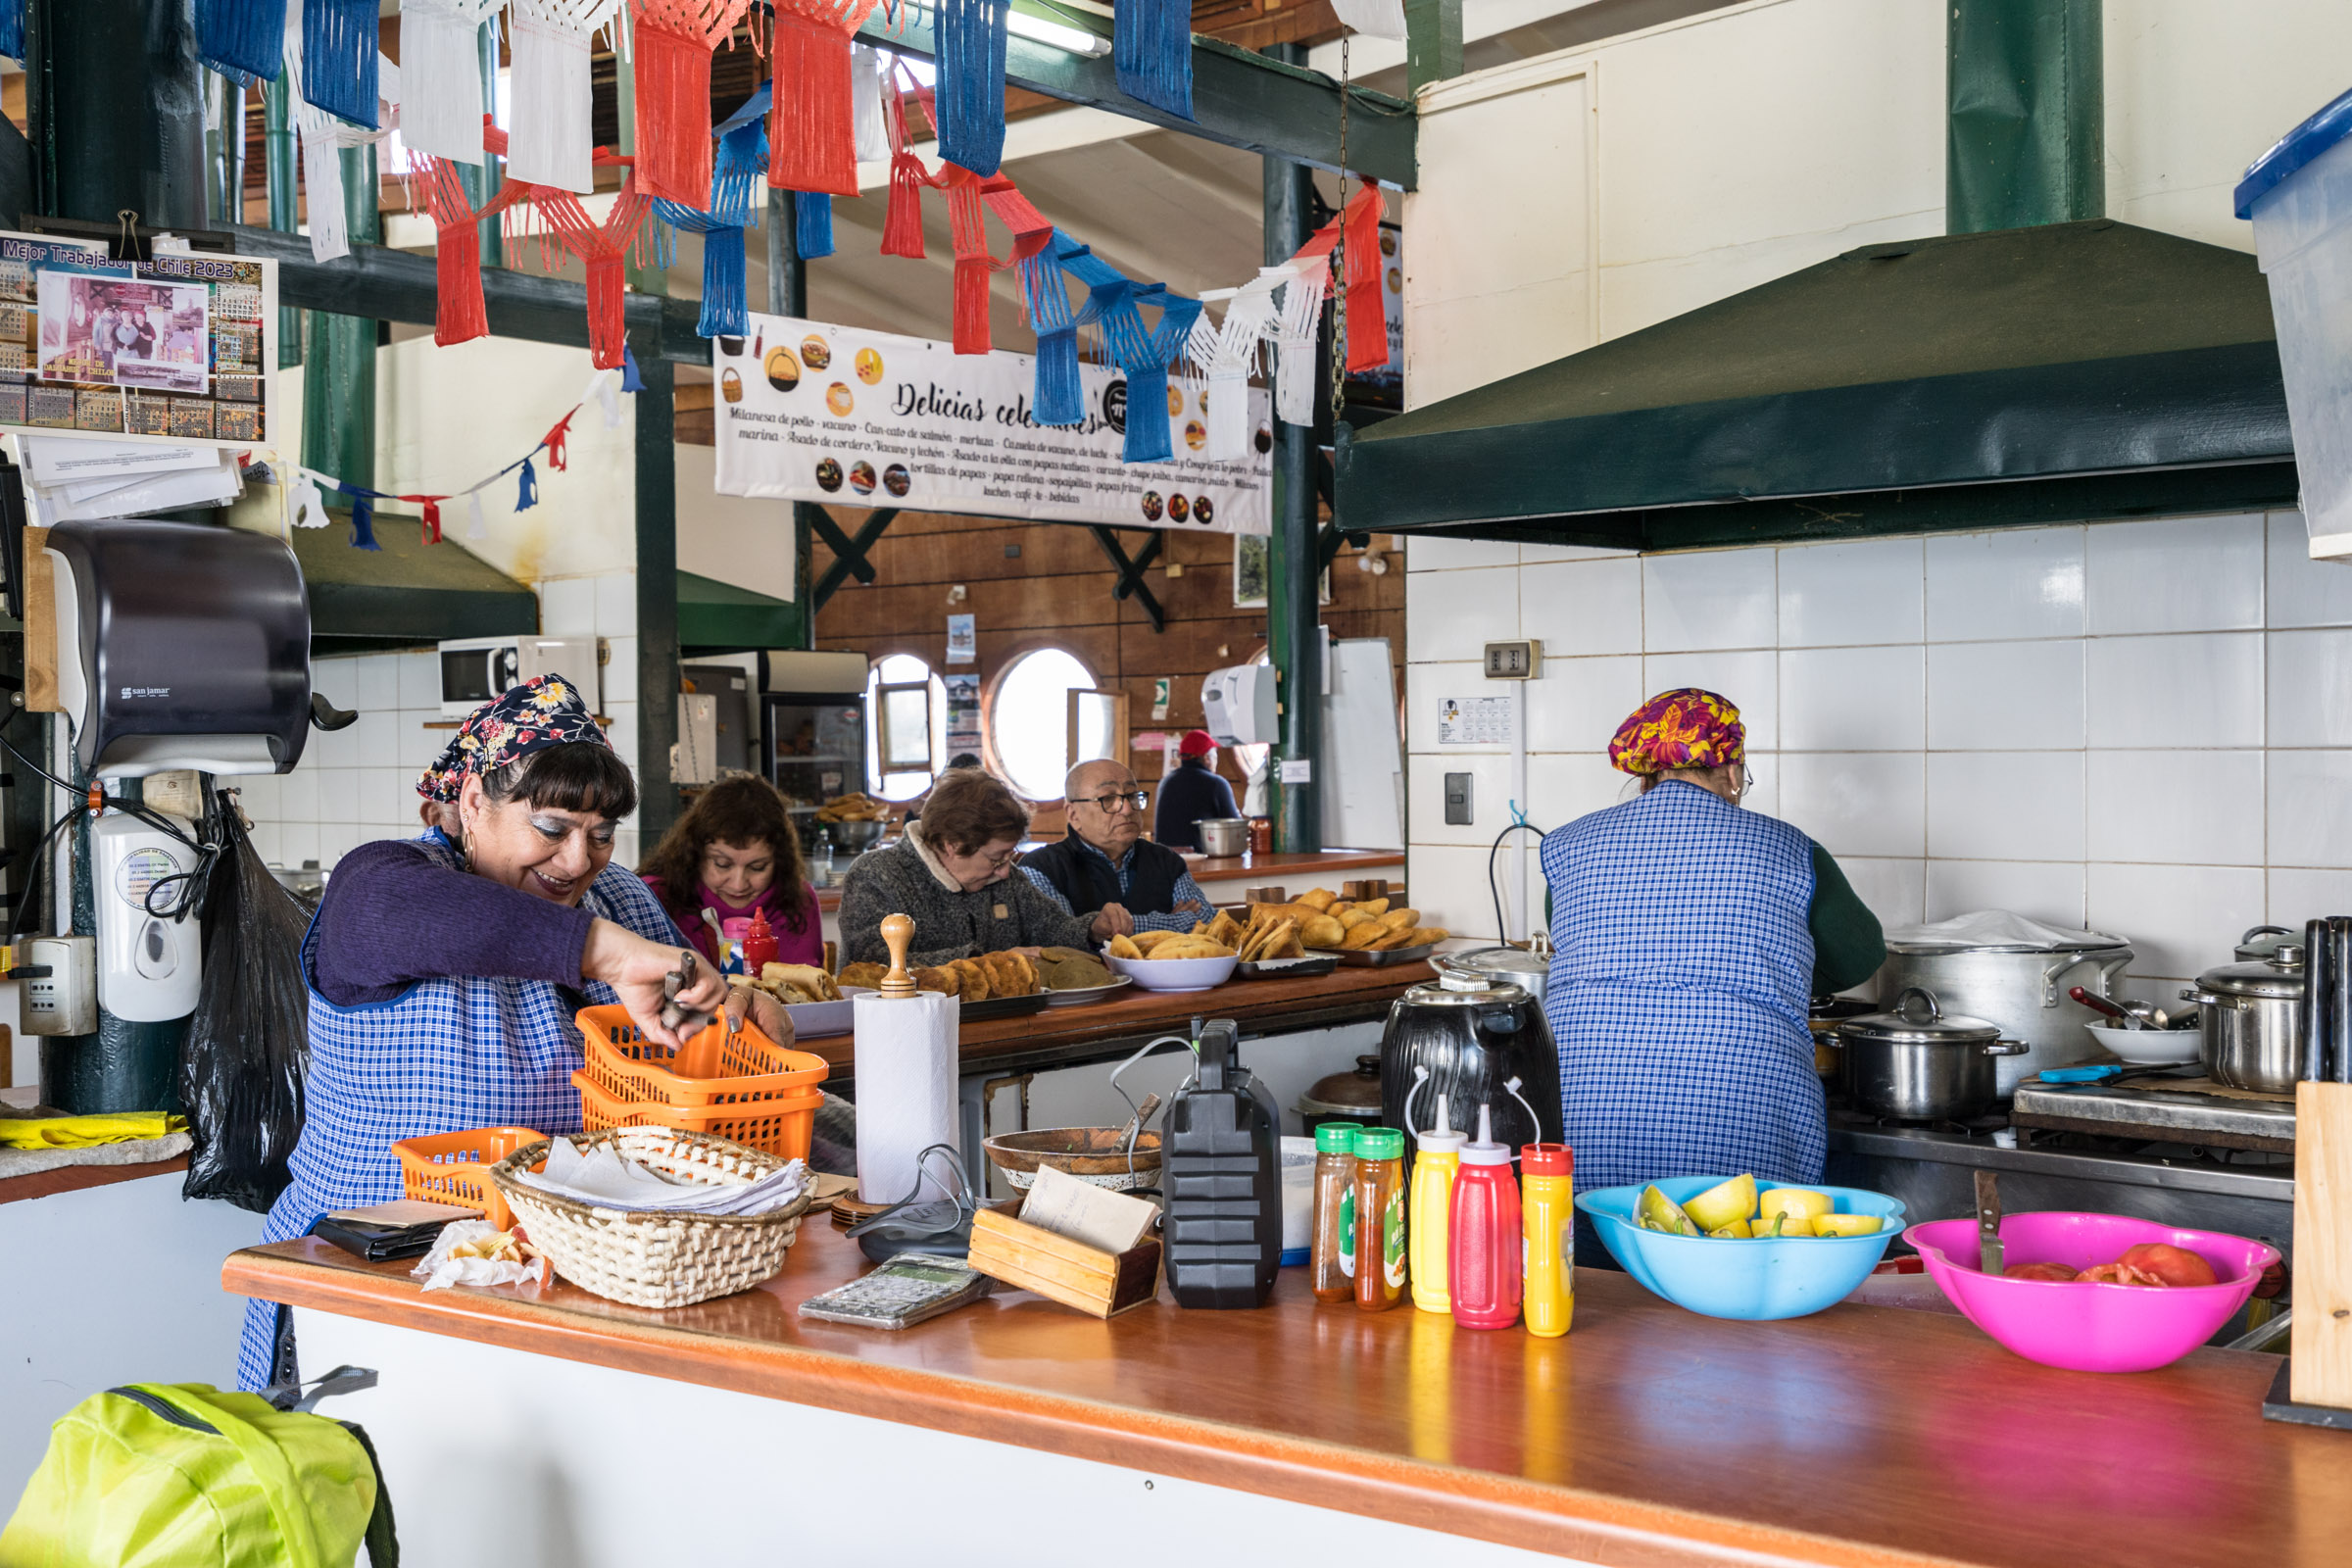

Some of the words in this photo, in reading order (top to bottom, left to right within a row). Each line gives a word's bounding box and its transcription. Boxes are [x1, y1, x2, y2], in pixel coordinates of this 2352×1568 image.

[3, 240, 47, 262] Mejor
[50, 246, 132, 269] Trabajador
[157, 258, 191, 274] Chile
[195, 261, 234, 278] 2023
[890, 381, 987, 421] Delicias
[729, 407, 776, 423] Milanesa
[778, 414, 789, 424] de
[791, 416, 814, 428] pollo
[822, 420, 857, 431] vacuno
[907, 428, 917, 438] de
[959, 435, 994, 447] merluza
[1003, 438, 1035, 451] Cazuela
[1037, 442, 1047, 452] de
[1079, 447, 1089, 457] de
[738, 429, 779, 442] marina
[787, 431, 818, 445] Asado
[820, 436, 831, 447] de
[873, 440, 908, 454] Vacuno
[910, 447, 916, 458] y
[952, 449, 981, 463] Asado
[982, 455, 988, 463] a
[990, 453, 999, 464] la
[1000, 454, 1016, 465] olla
[1018, 458, 1033, 467] con
[1034, 460, 1060, 471] papas
[1060, 462, 1091, 473] nativas
[910, 463, 946, 475] tortillas
[948, 466, 958, 476] de
[959, 469, 986, 481] papas
[993, 473, 1015, 483] papa
[1016, 473, 1044, 484] rellena
[1121, 483, 1143, 494] fritas
[983, 486, 1011, 498] kuchen
[1049, 491, 1080, 504] bebidas
[147, 686, 171, 695] jamar
